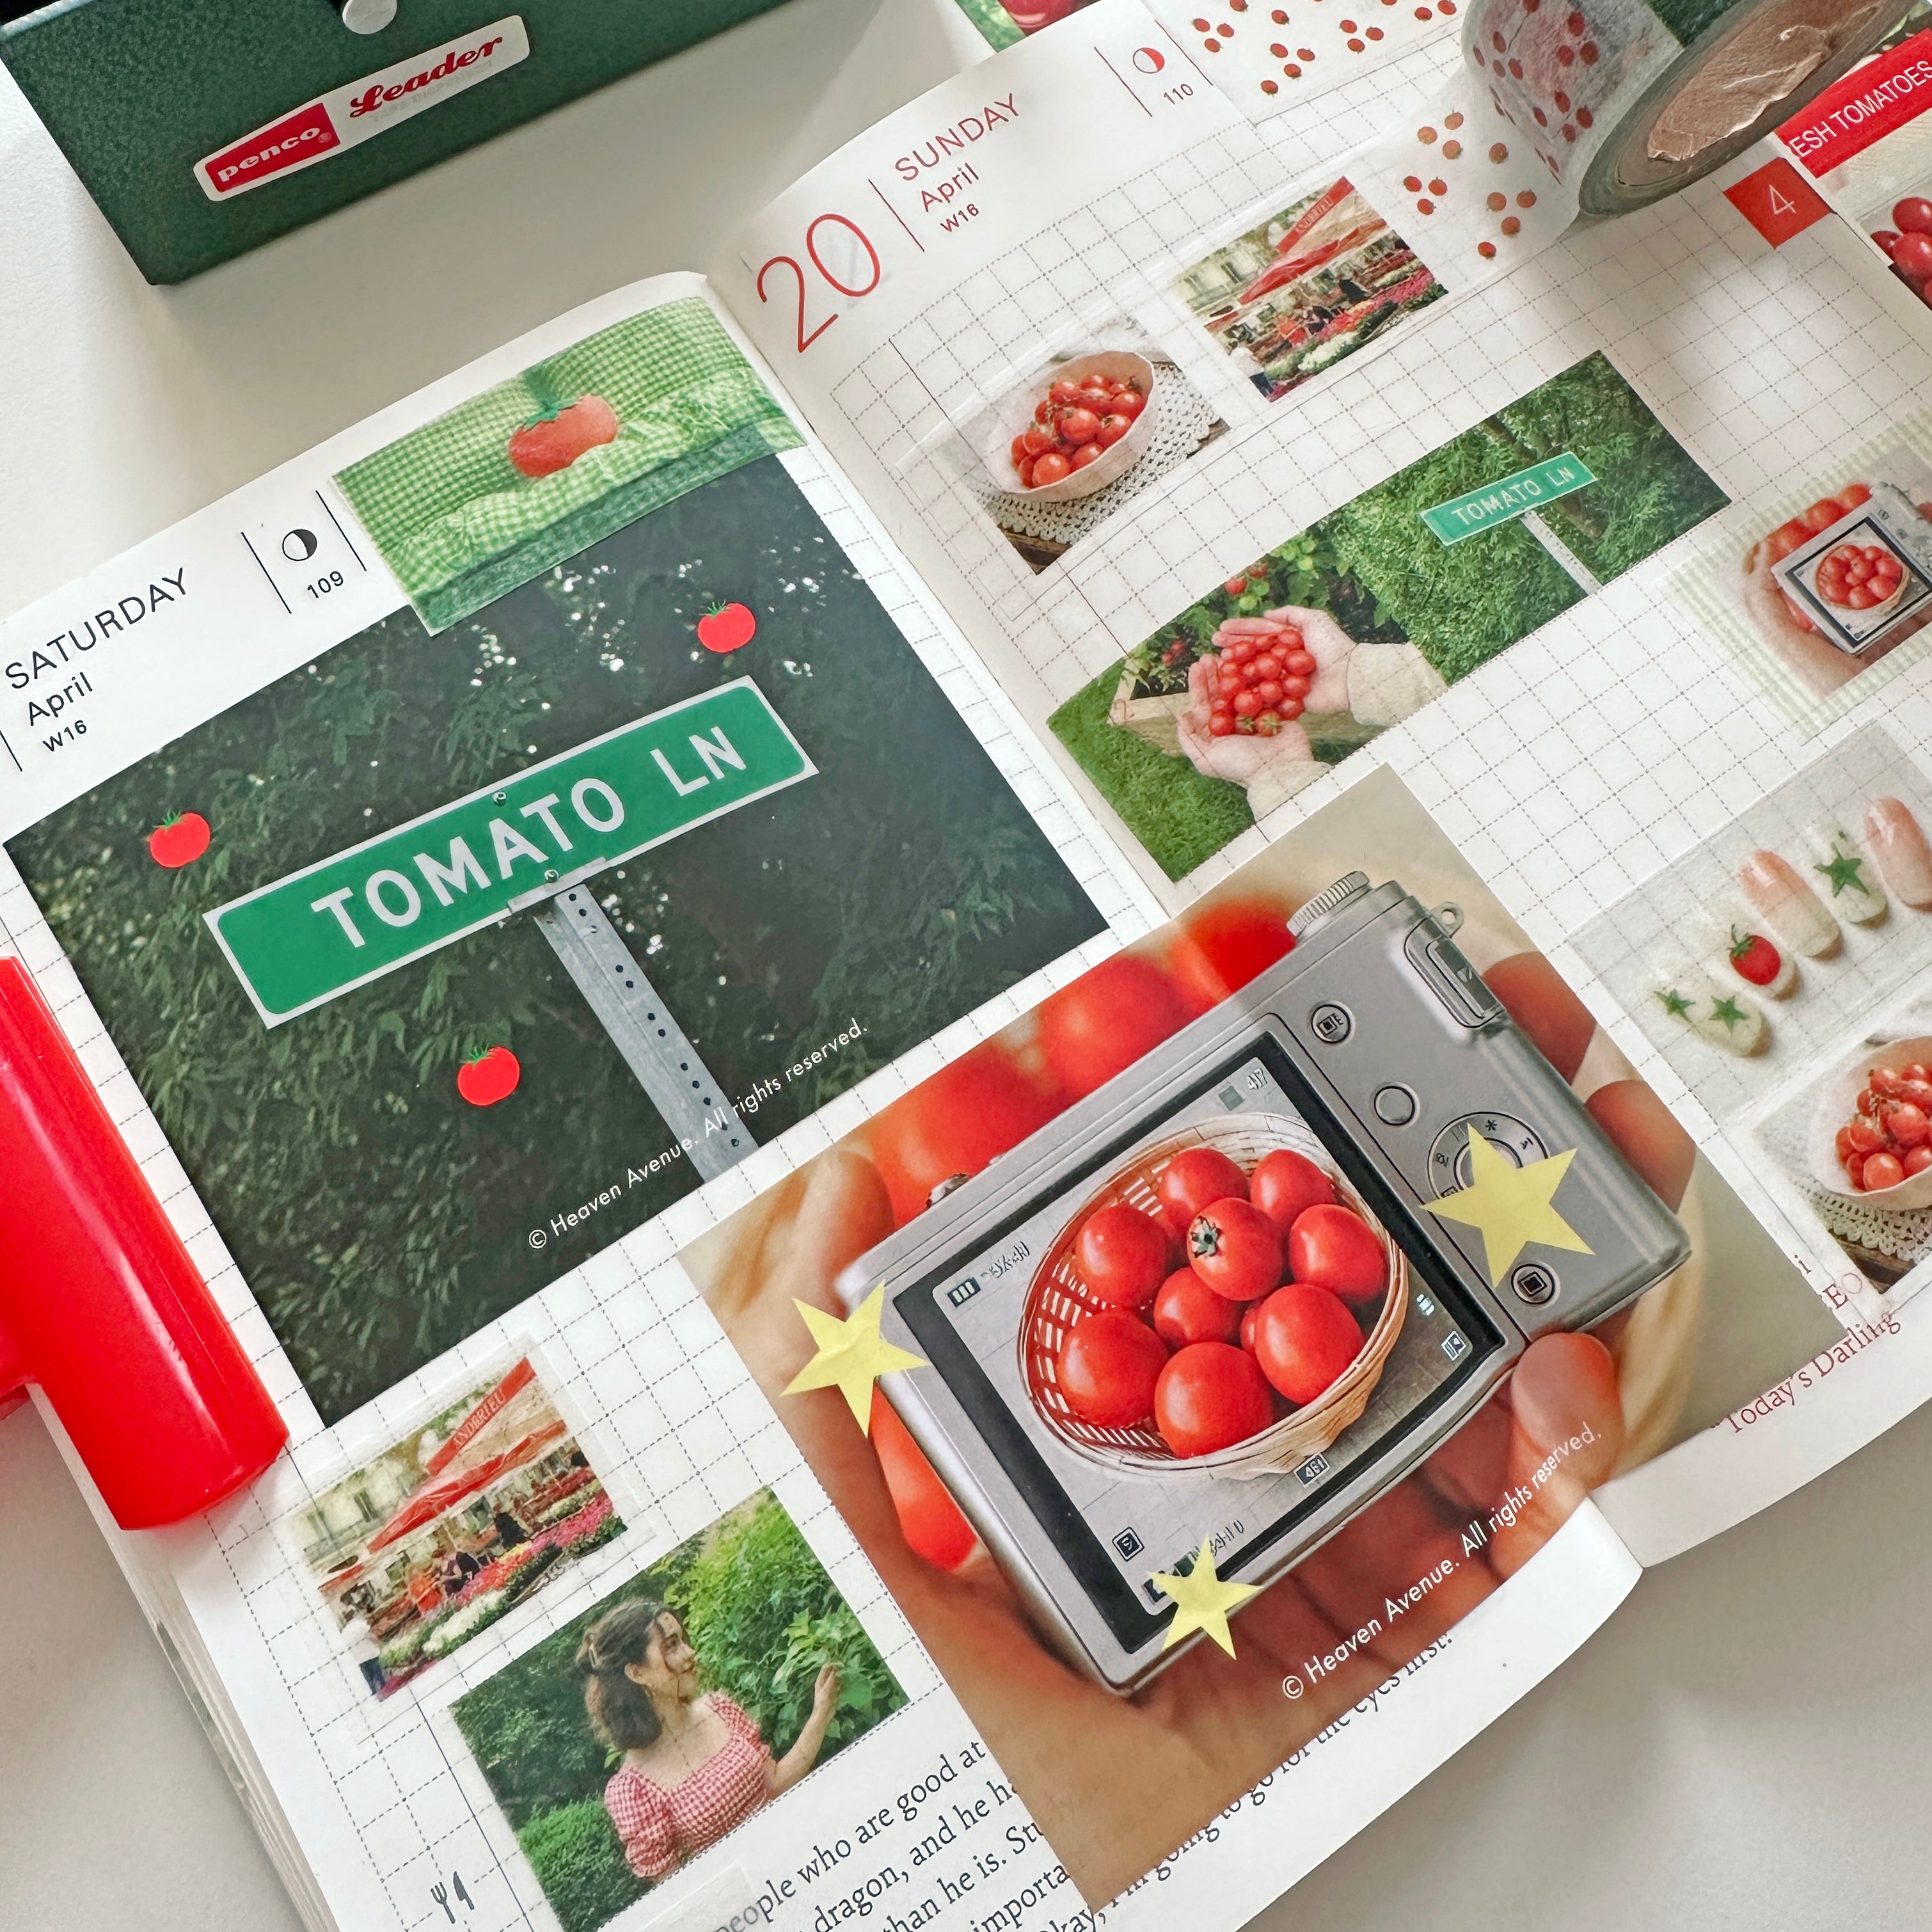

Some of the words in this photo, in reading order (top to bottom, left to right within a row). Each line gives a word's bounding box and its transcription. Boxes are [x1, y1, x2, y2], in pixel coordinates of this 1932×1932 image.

[349, 36, 503, 118] Leader
[1163, 83, 1194, 106] 110
[1829, 60, 1932, 130] TOMATOES
[218, 127, 321, 182] penco
[895, 93, 1020, 182] SUNDAY
[920, 162, 979, 212] April
[940, 203, 979, 233] W16
[1768, 183, 1797, 216] 4
[757, 213, 880, 353] 20
[1451, 480, 1542, 525] TOMATO
[1546, 466, 1575, 486] LN
[306, 571, 344, 599] 109
[4, 567, 186, 689] SATURDAY
[28, 672, 93, 726] April
[43, 719, 88, 752] W16
[310, 777, 626, 948] TOMATO
[649, 725, 747, 797] LN
[550, 1184, 622, 1237] Heaven
[626, 1137, 699, 1189] Avenue.
[704, 1106, 729, 1137] All
[732, 1077, 782, 1118] rights
[785, 1017, 868, 1082] reserved.
[1812, 1312, 1901, 1377] Darling
[1304, 1619, 1382, 1684] Heaven
[1384, 1558, 1460, 1622] Avenue.
[1460, 1521, 1488, 1558] All
[1489, 1483, 1533, 1534] rights
[1532, 1420, 1603, 1491] reserved.
[796, 1837, 853, 1887] who
[855, 1808, 895, 1844] are
[897, 1754, 959, 1822] good
[959, 1738, 987, 1770] at
[814, 1859, 911, 1932] dragon,
[908, 1815, 958, 1867] and
[952, 1798, 990, 1831] he
[937, 1871, 976, 1904] he
[973, 1852, 1007, 1880] is.
